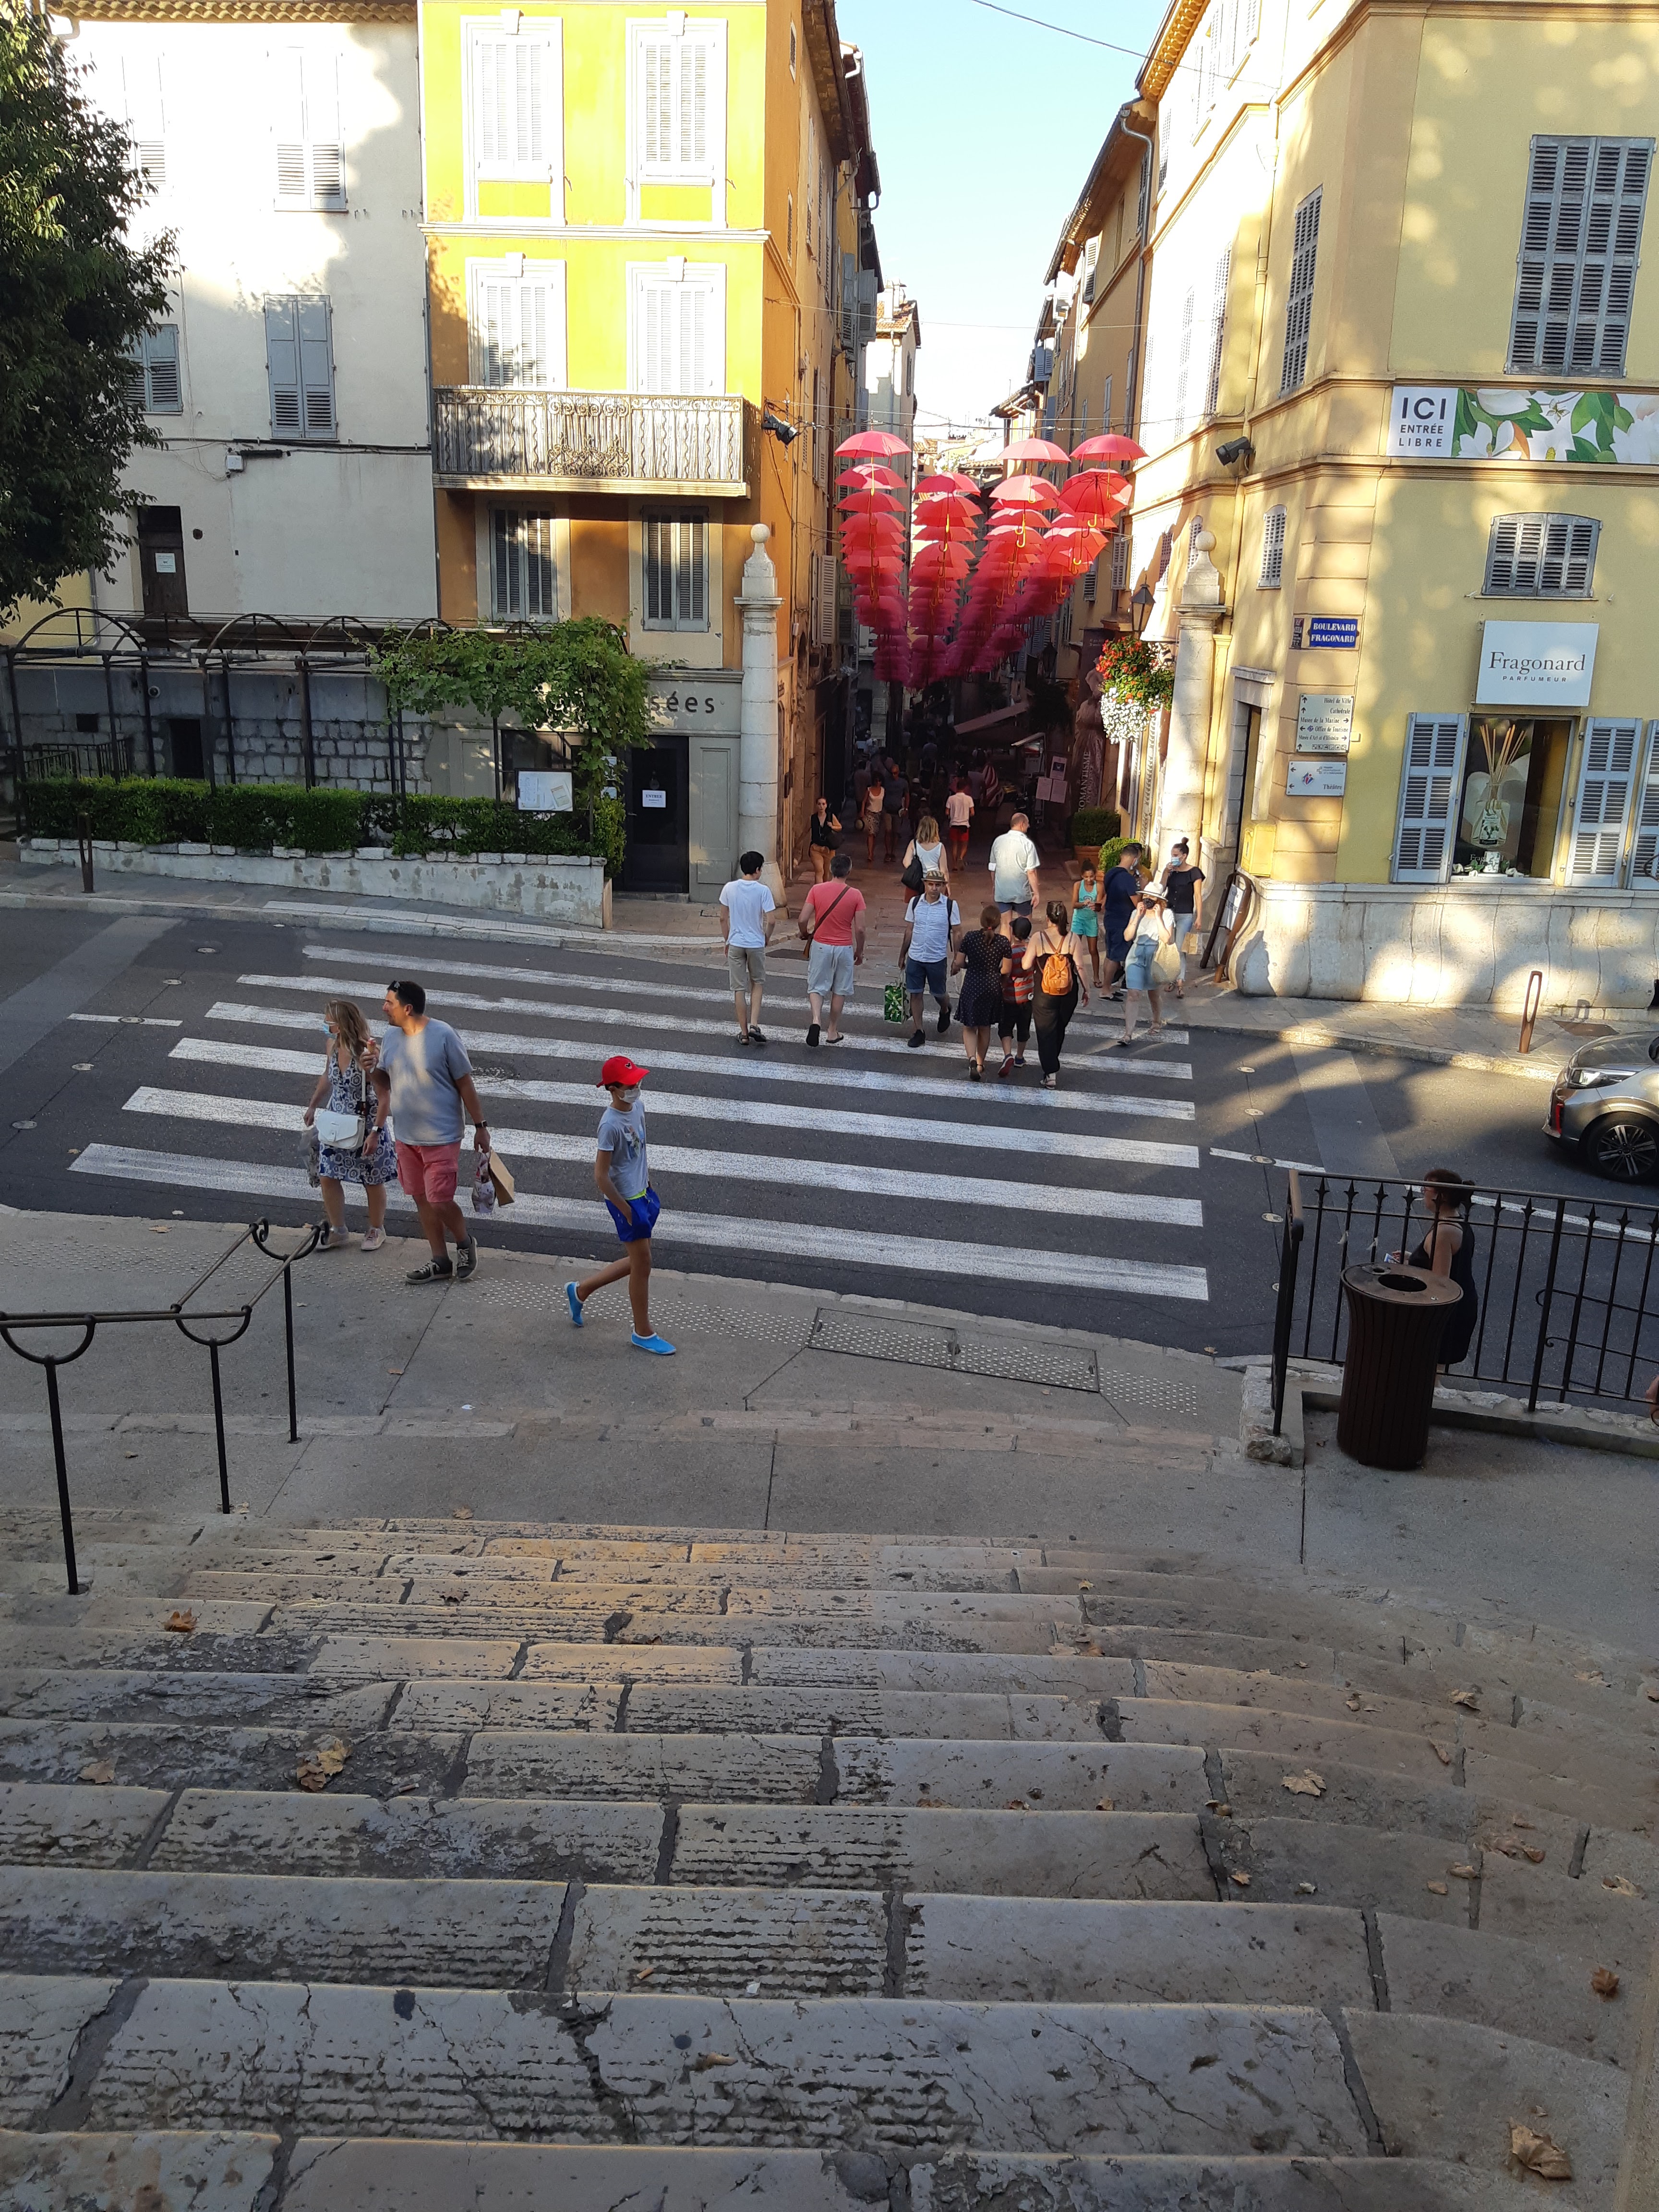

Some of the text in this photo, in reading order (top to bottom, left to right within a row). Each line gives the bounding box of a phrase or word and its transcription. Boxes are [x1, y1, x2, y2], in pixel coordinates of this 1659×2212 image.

[1402, 397, 1446, 420] ICI
[1400, 423, 1443, 434] ENTRÉE
[1399, 438, 1442, 447] LIBRE
[1313, 623, 1356, 631] BOULEVARD
[1311, 634, 1354, 643] FRAGONARD
[1488, 651, 1585, 674] Fragonard
[650, 691, 715, 713] sées
[1078, 751, 1091, 812] ROMANTISME
